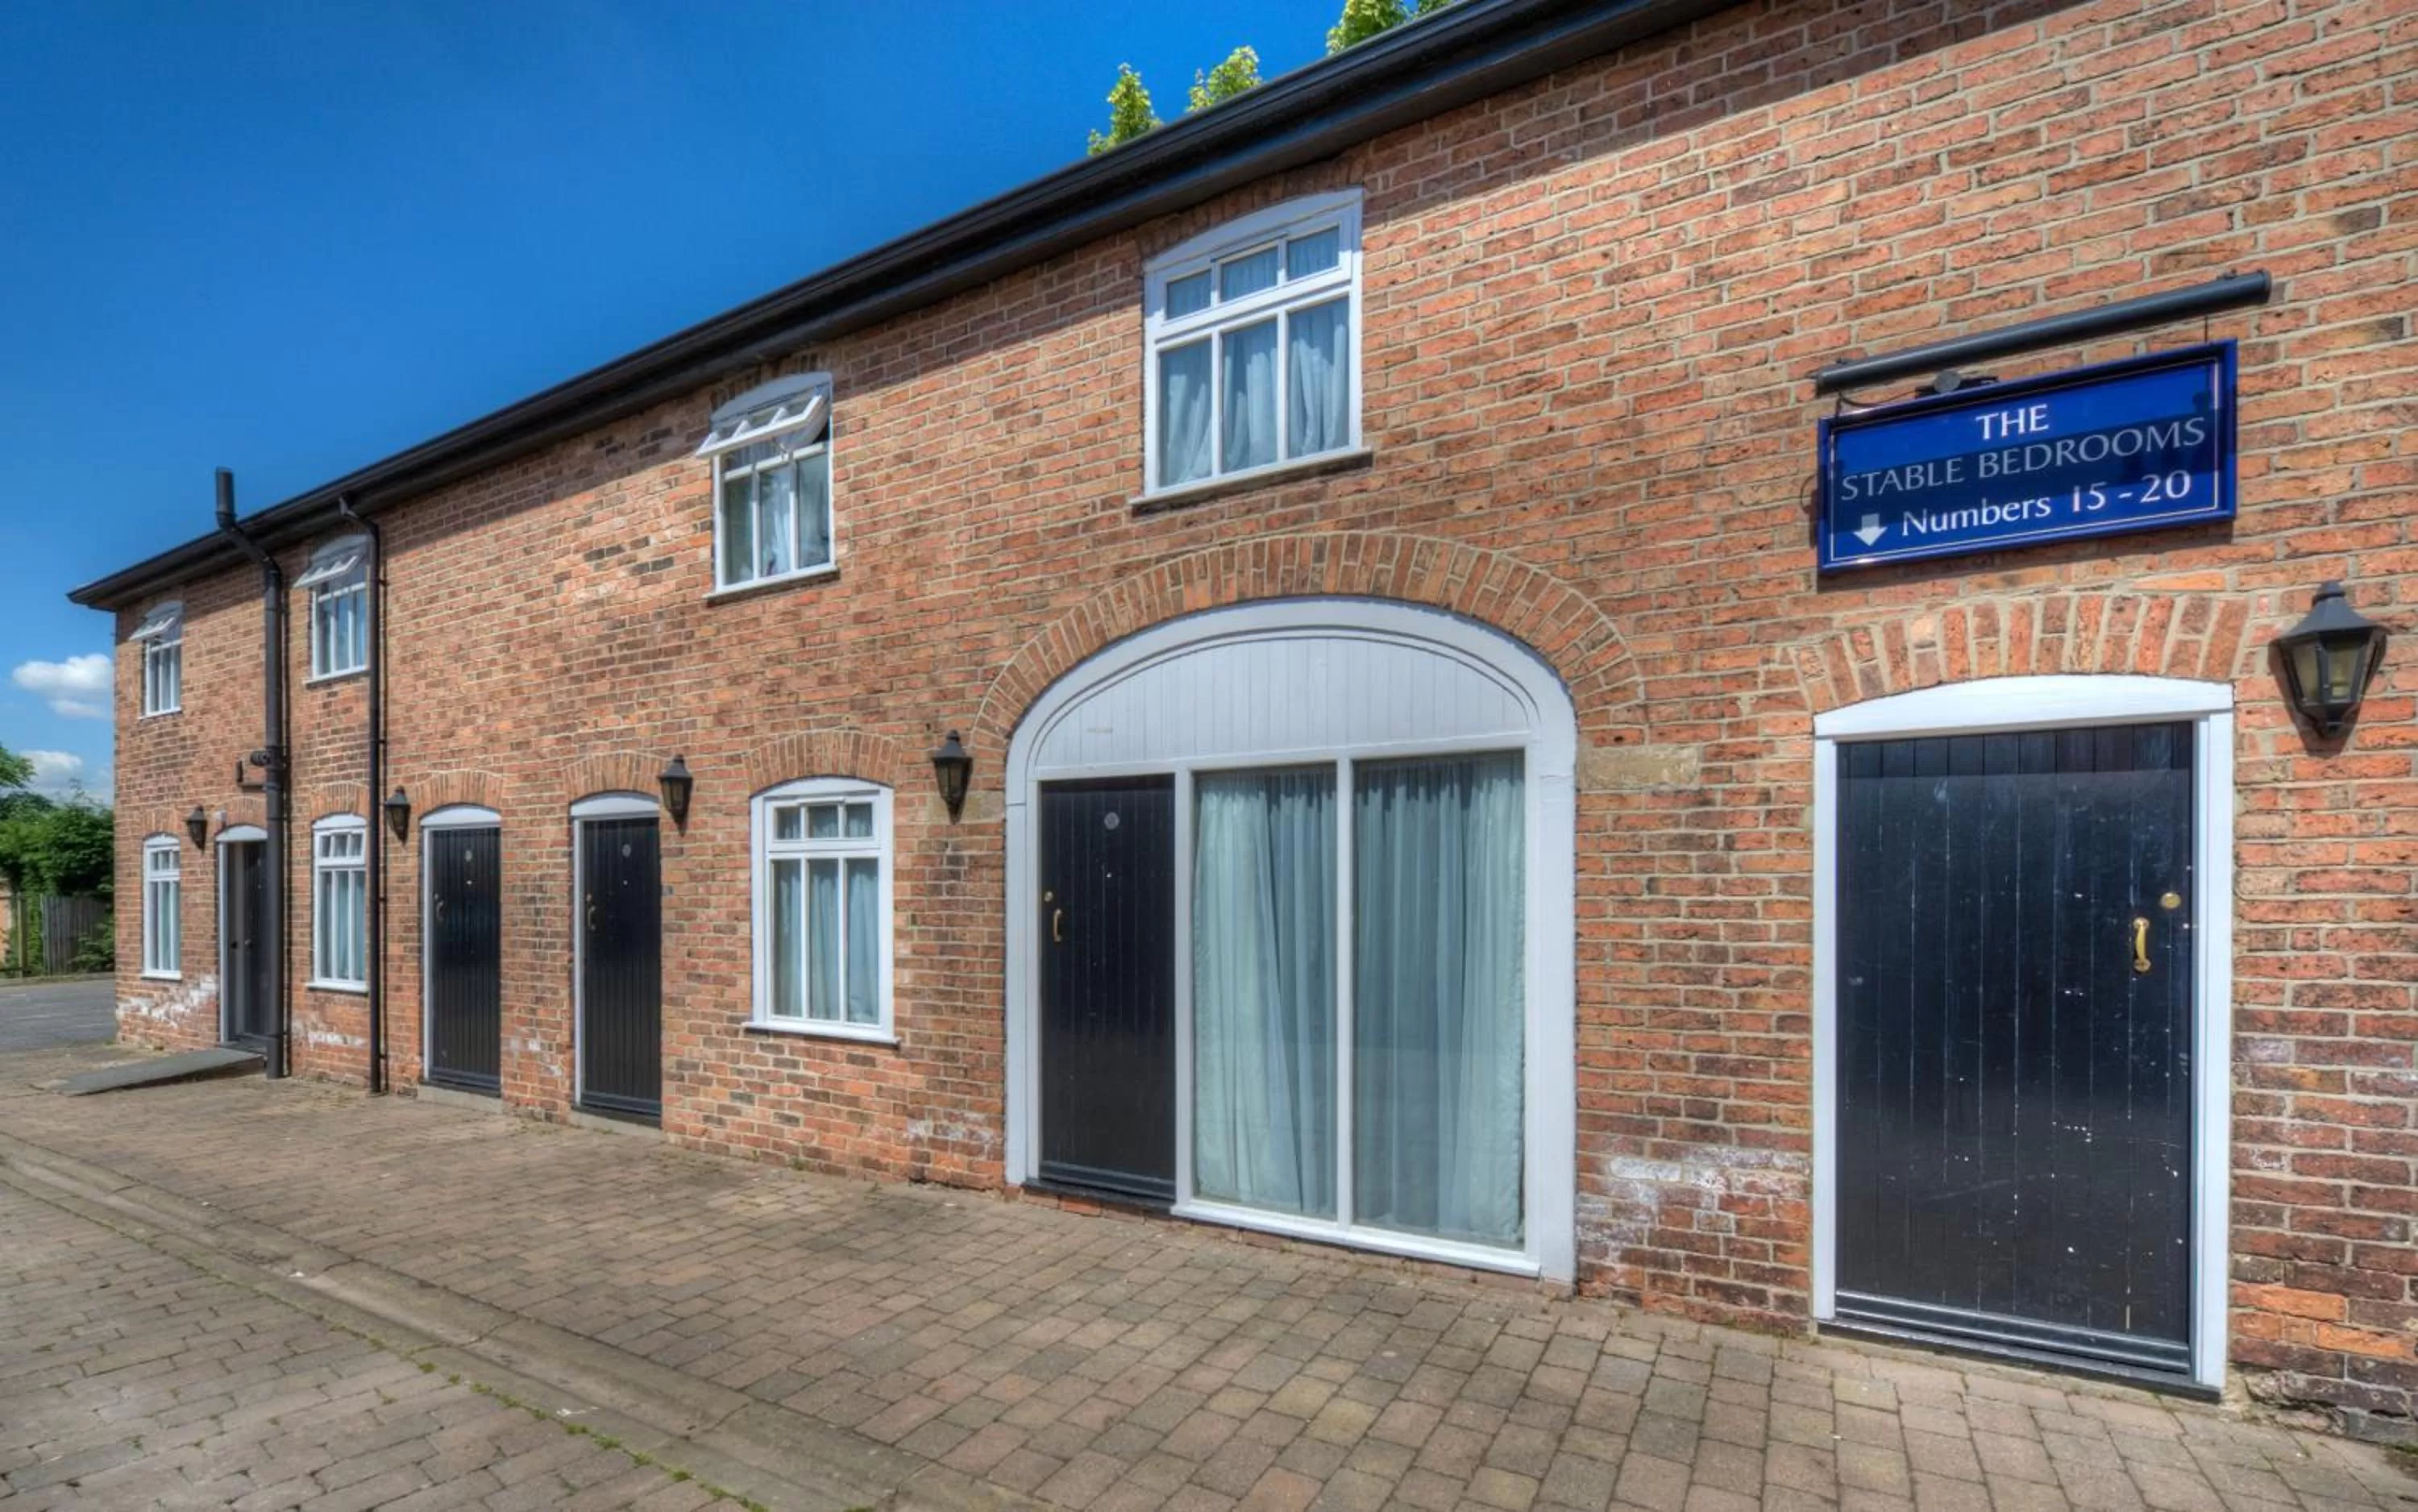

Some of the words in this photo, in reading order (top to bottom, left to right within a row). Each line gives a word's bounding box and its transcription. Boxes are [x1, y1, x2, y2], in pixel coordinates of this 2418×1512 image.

[1977, 404, 2049, 440] THE
[1841, 458, 1965, 501] STABLE
[1979, 417, 2205, 479] BEDROOMS
[1902, 496, 2051, 536] Numbers
